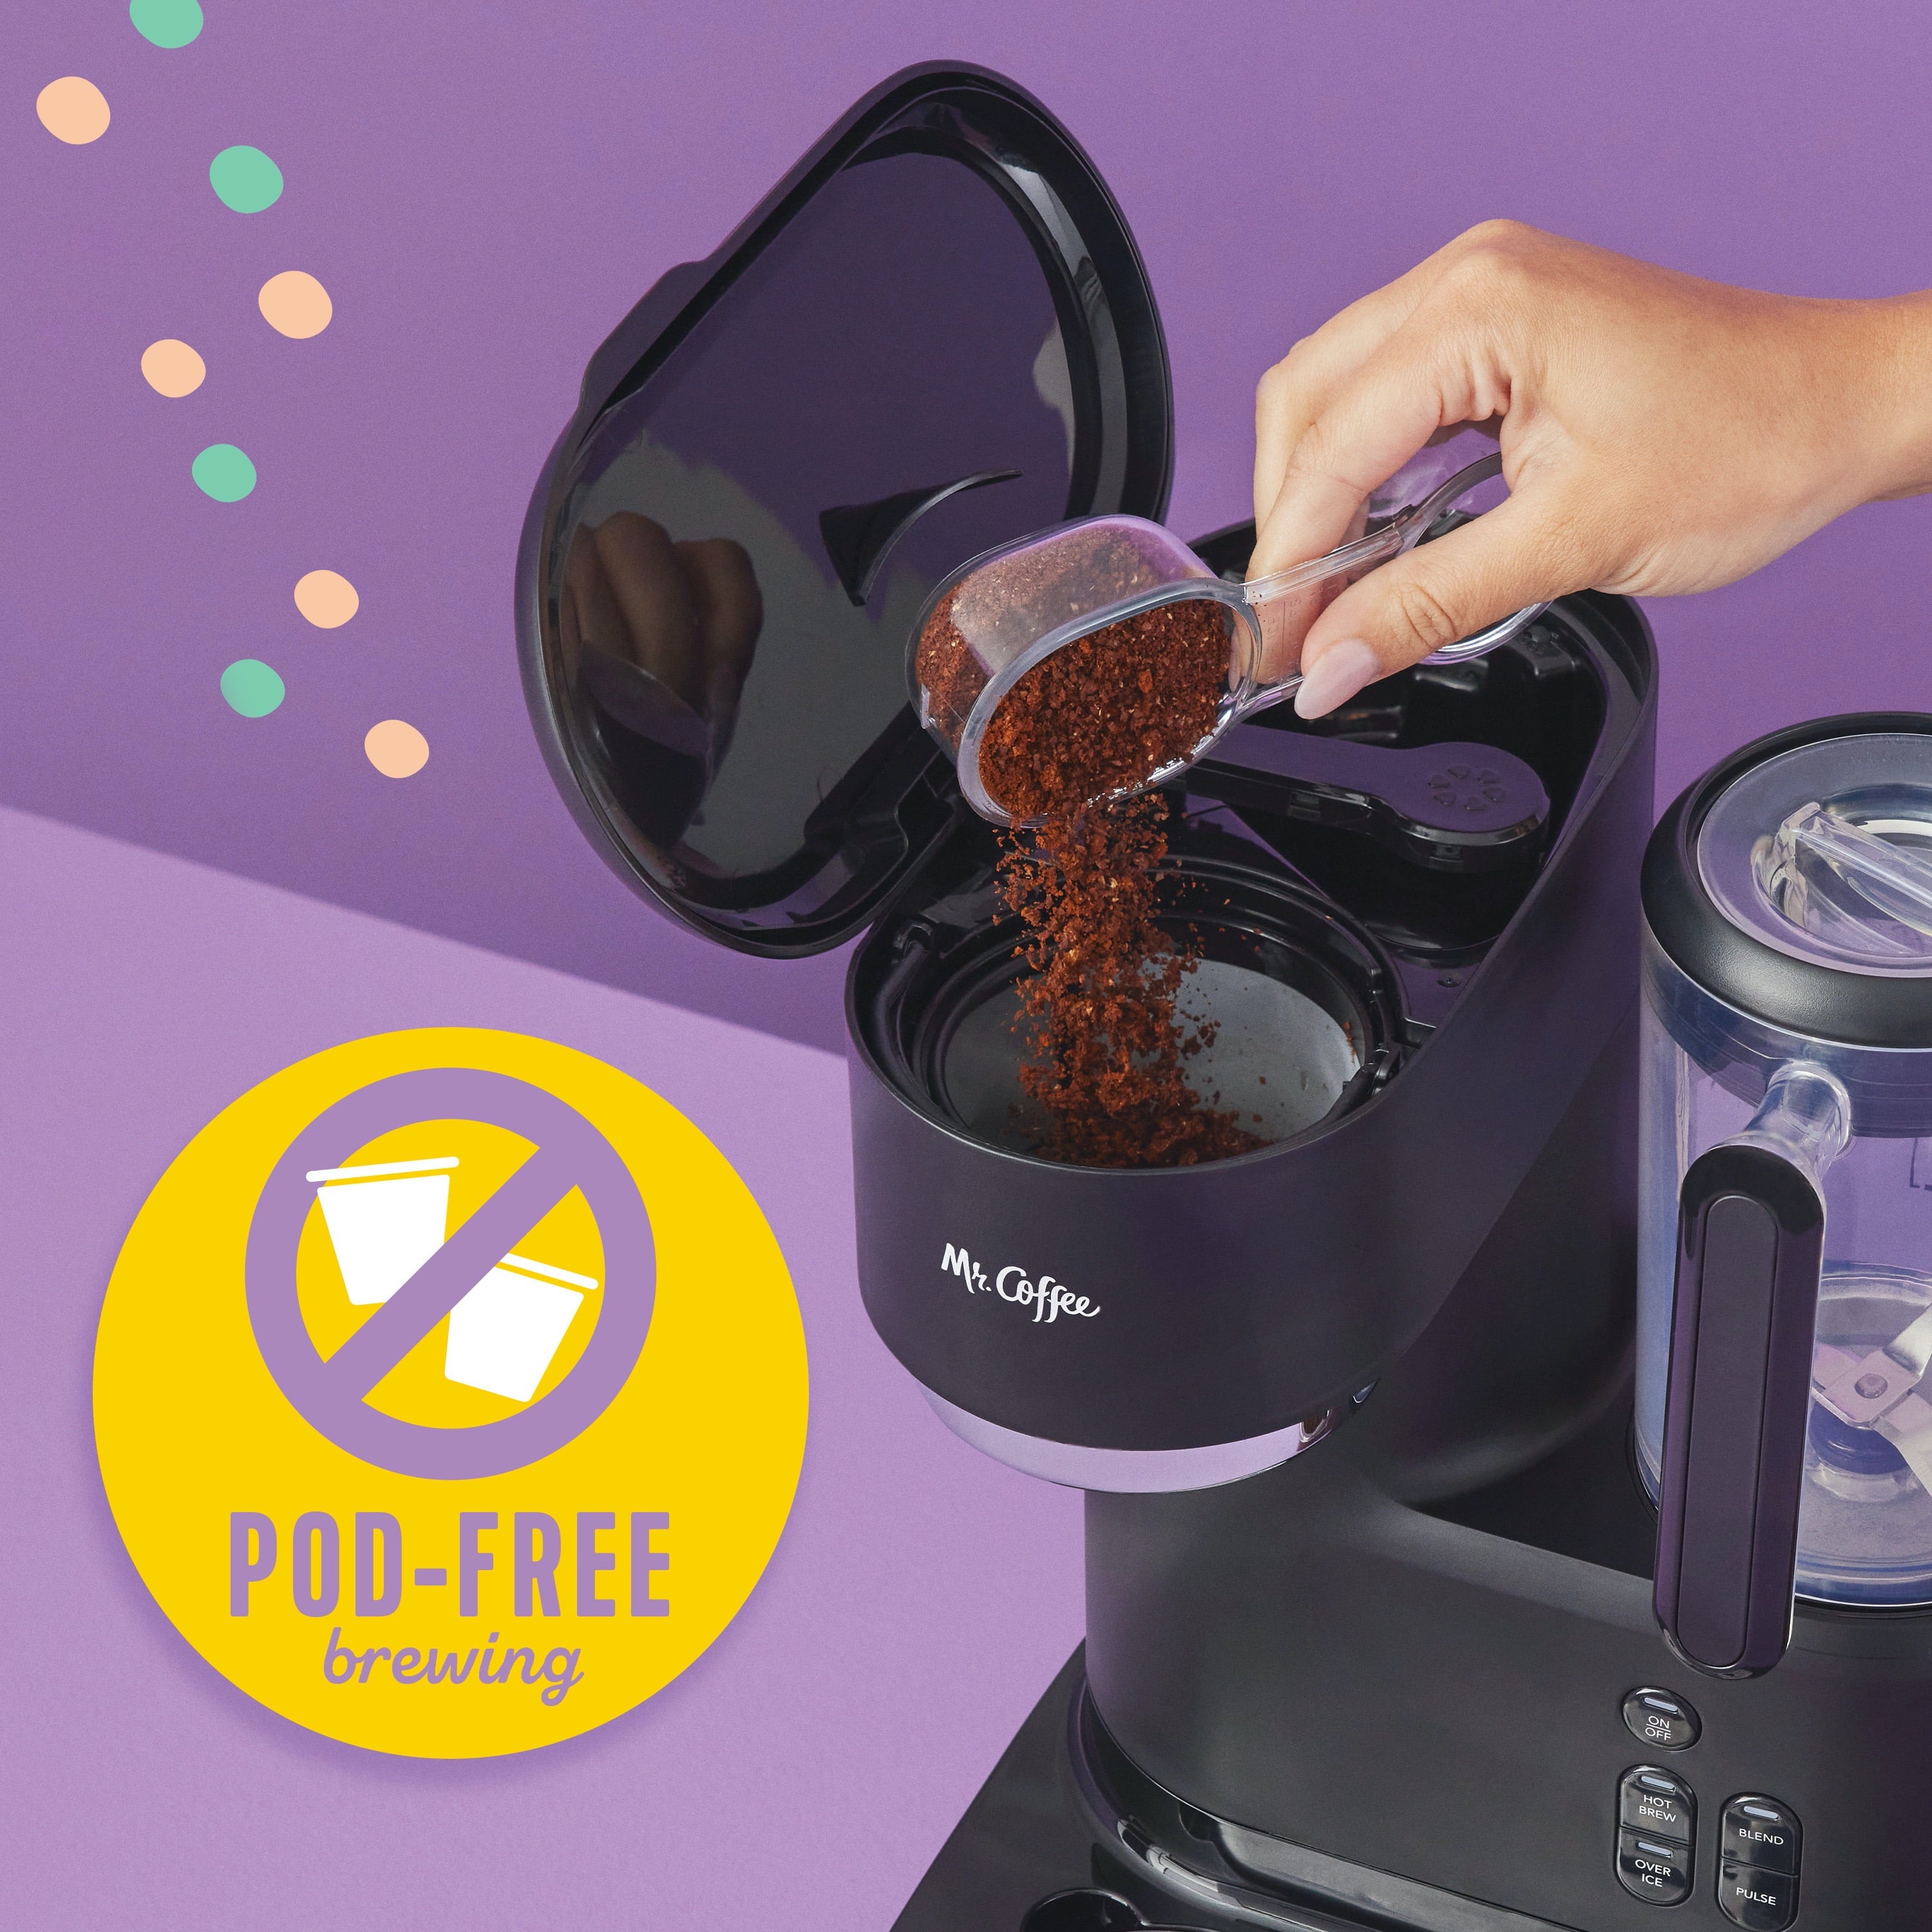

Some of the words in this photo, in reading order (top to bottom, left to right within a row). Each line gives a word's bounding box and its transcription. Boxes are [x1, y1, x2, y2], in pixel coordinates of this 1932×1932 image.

[941, 1243, 992, 1294] Mr.
[996, 1266, 1101, 1323] Coffee
[1648, 1716, 1669, 1729] ON
[1645, 1727, 1672, 1741] OFF
[1643, 1794, 1672, 1809] HOT
[1639, 1805, 1676, 1823] BREW
[1739, 1828, 1784, 1845] BLEND
[1634, 1859, 1671, 1877] OVER
[1642, 1873, 1663, 1887] ICE
[1736, 1887, 1776, 1906] PULSE
